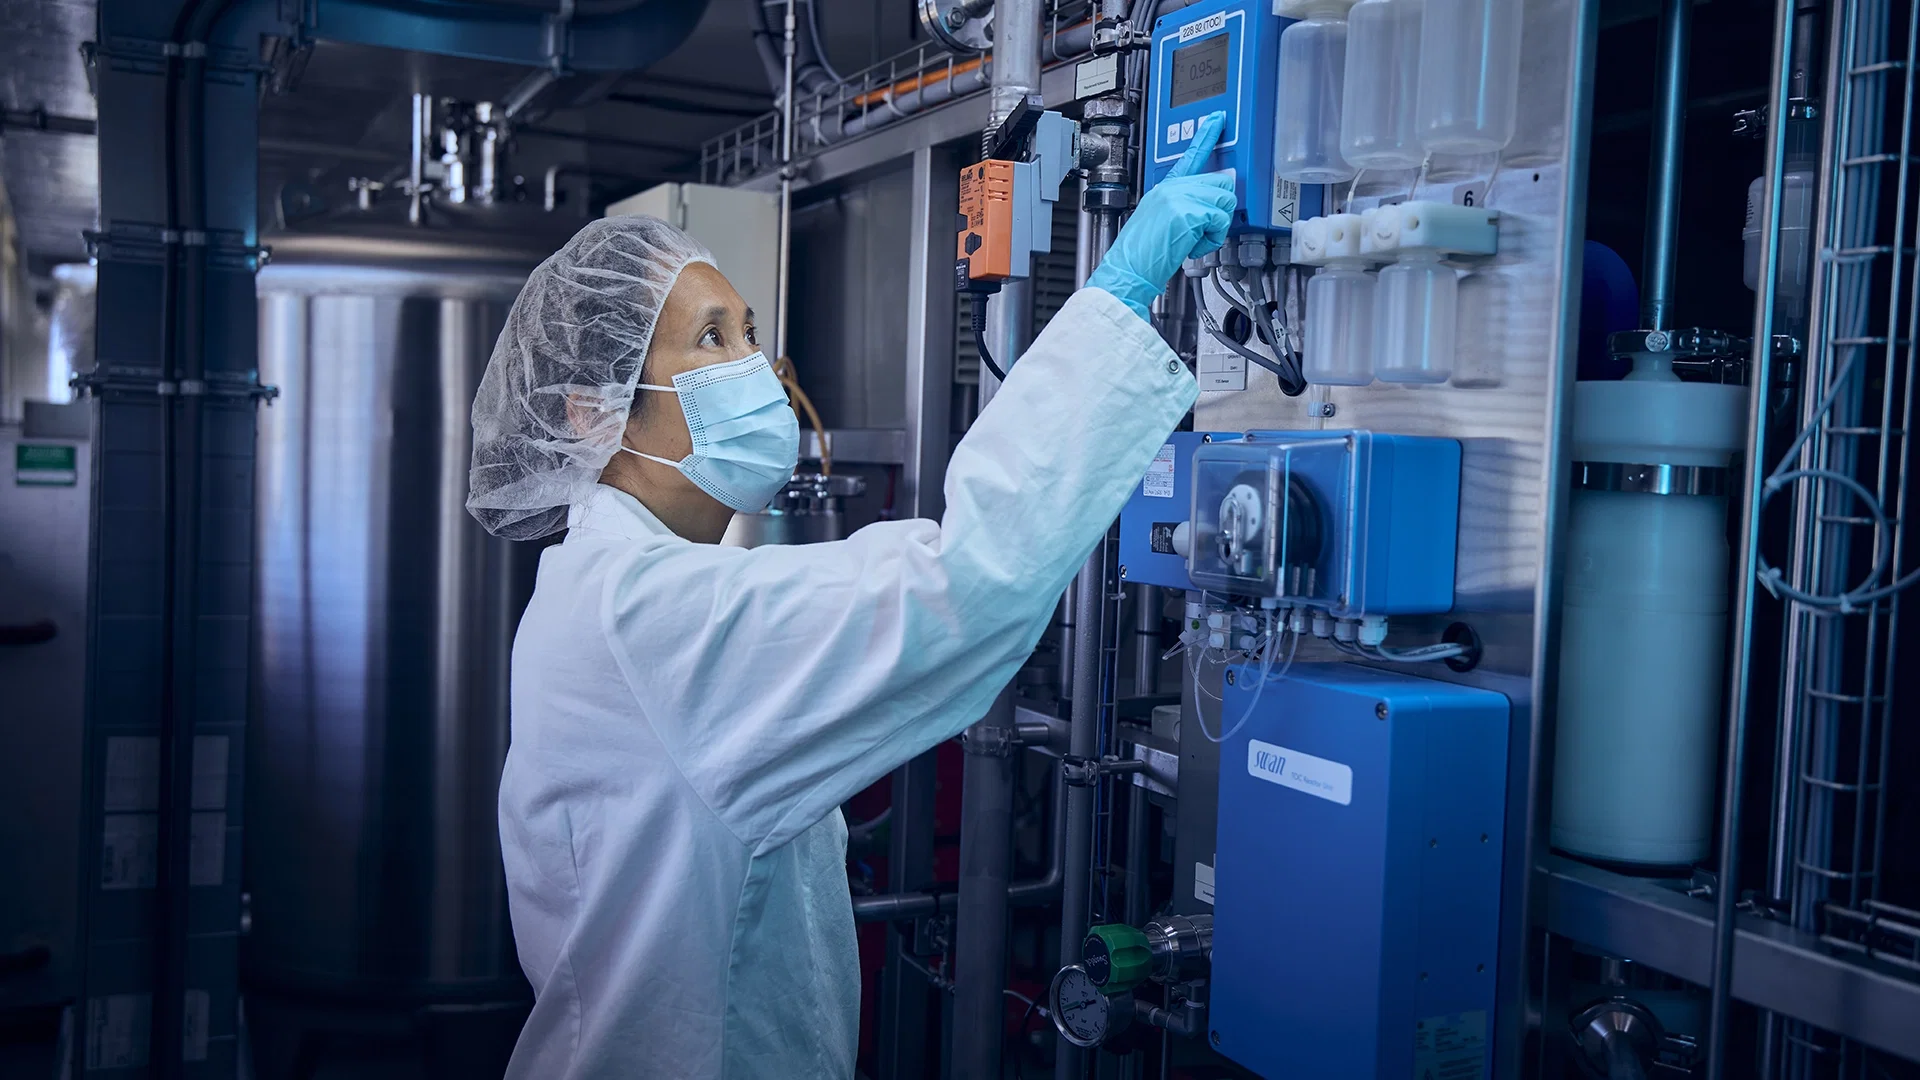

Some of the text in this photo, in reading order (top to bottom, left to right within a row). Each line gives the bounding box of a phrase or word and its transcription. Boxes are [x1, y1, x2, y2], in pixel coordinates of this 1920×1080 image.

[1182, 17, 1222, 38] 228 92 (TOC)
[1189, 59, 1213, 81] 0.95
[1463, 190, 1474, 207] 6
[1254, 750, 1287, 776] swan
